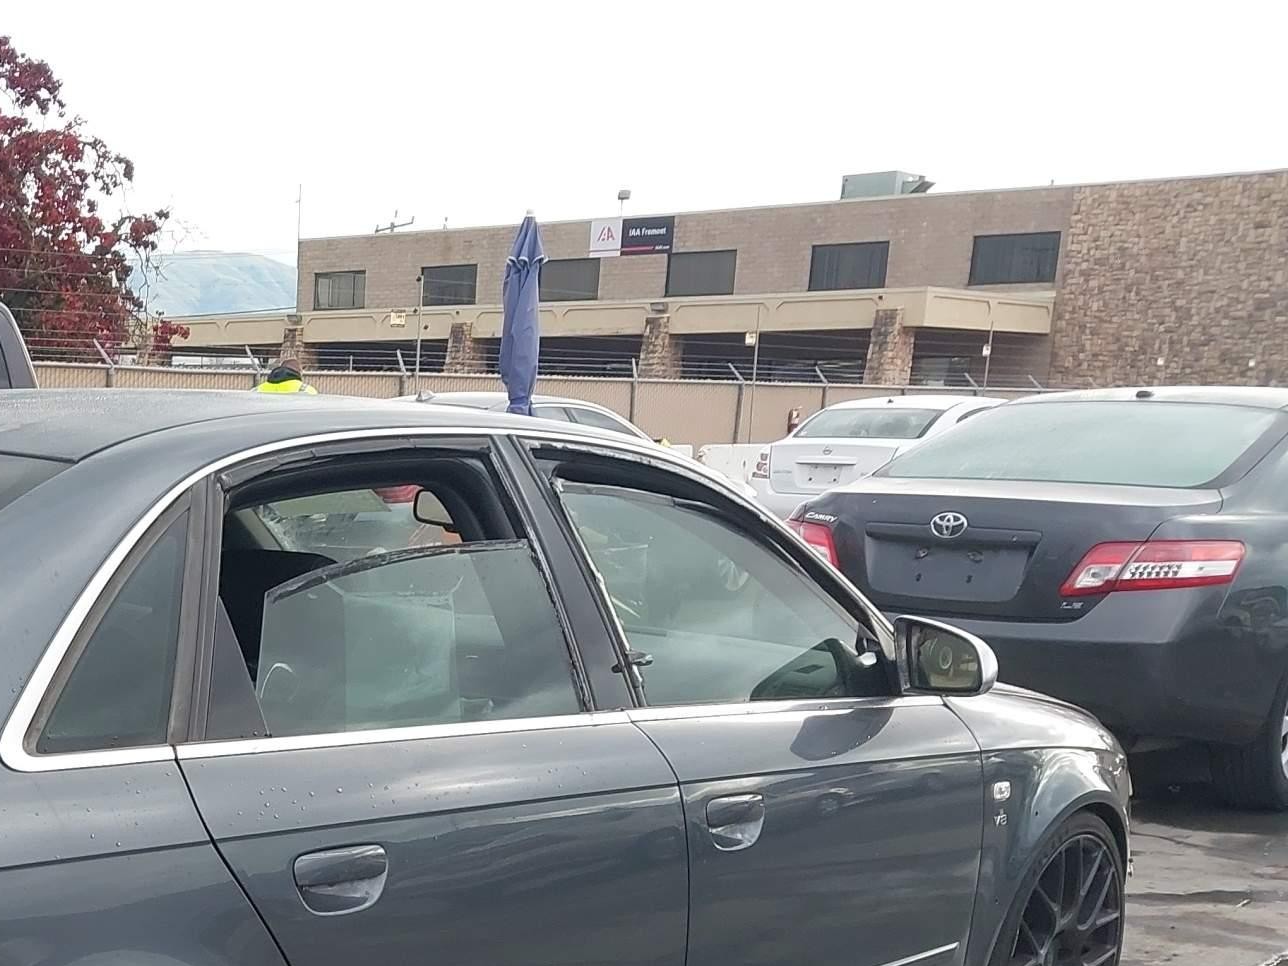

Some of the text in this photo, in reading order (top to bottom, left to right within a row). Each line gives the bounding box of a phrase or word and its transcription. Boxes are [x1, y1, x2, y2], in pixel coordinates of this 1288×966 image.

[629, 226, 667, 237] IAA Fremont
[806, 511, 838, 522] CAMRY
